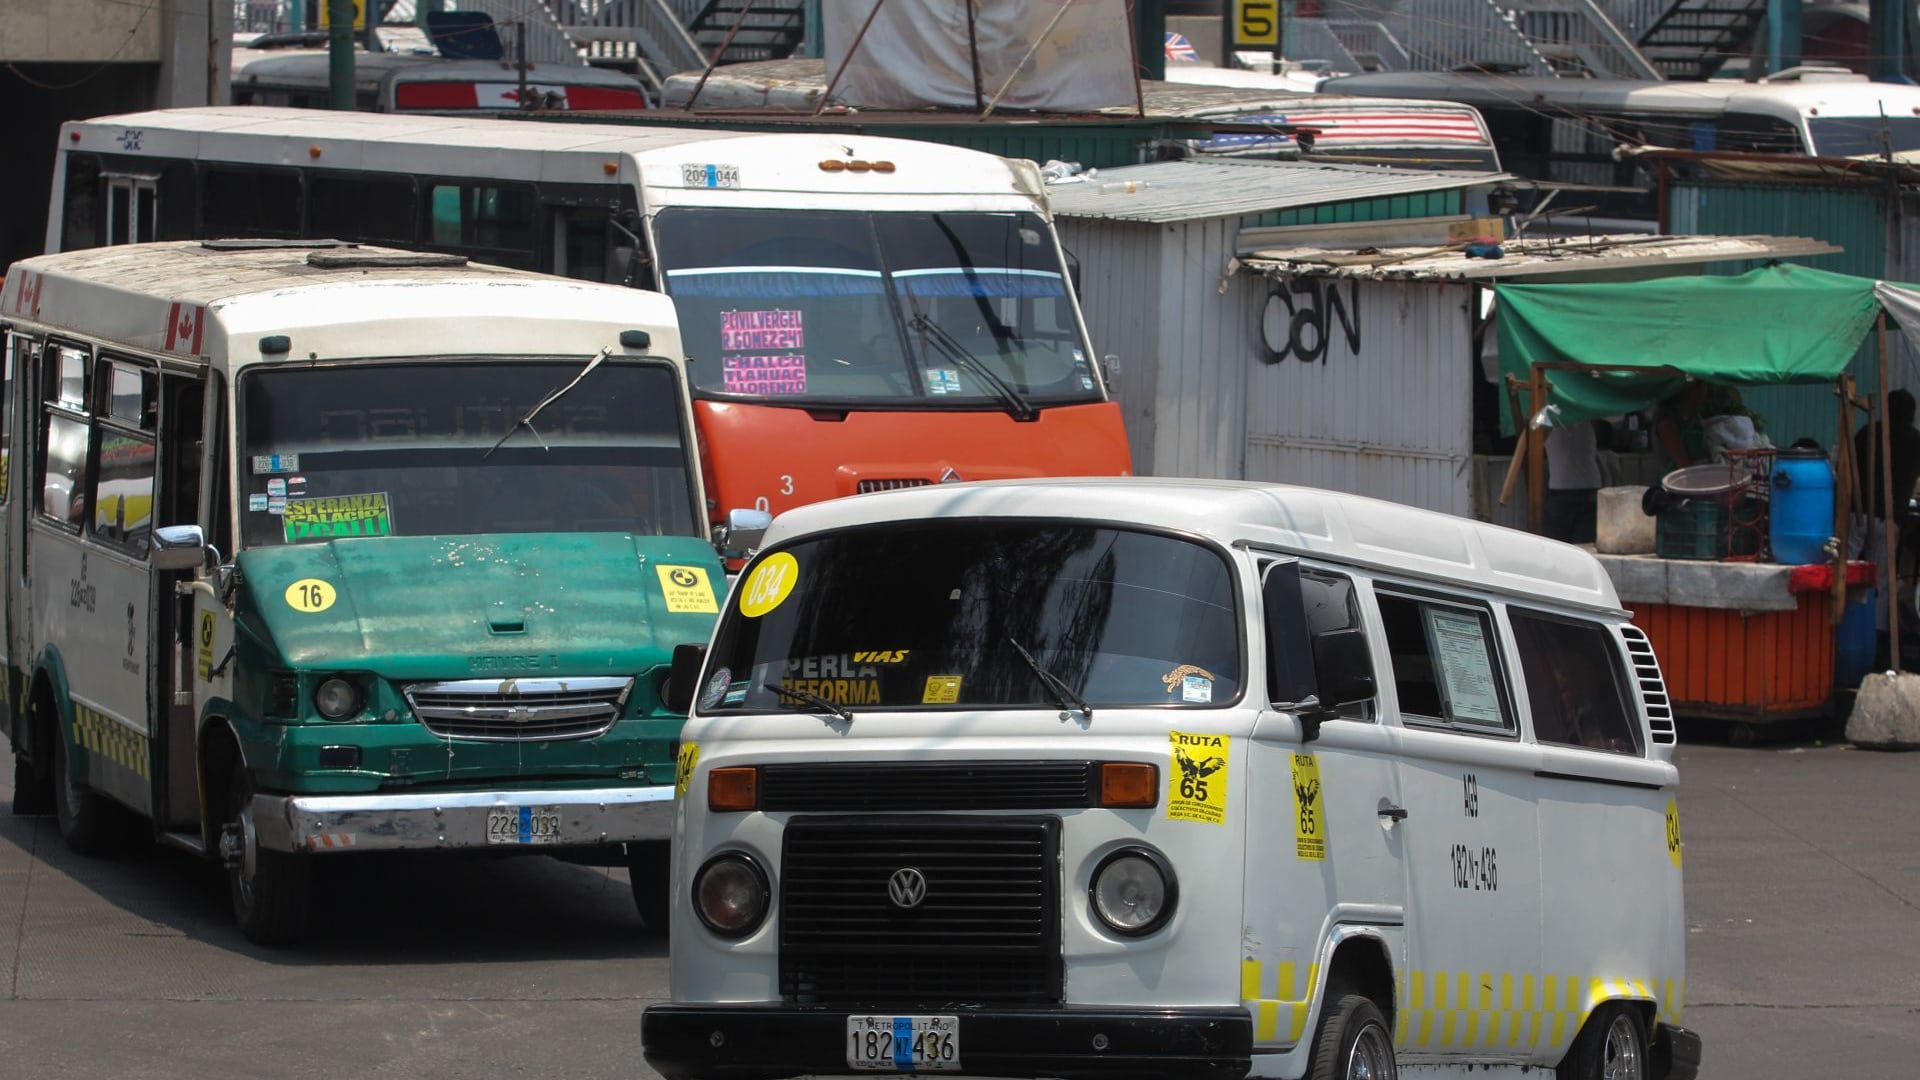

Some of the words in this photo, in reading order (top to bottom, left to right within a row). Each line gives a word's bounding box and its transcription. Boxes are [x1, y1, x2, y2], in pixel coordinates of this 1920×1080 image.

[1243, 4, 1272, 36] 5
[685, 169, 706, 182] 209
[716, 170, 738, 183] 044
[724, 357, 803, 369] CHALCO
[724, 368, 804, 381] TLAHUAC
[780, 475, 794, 495] 3
[285, 494, 386, 515] ESPERANZA
[748, 562, 788, 606] 034
[299, 584, 322, 608] 16
[784, 653, 877, 678] PERLA
[853, 650, 910, 663] VIAS
[780, 678, 880, 704] REFORMA
[1180, 735, 1222, 747] RUTA
[1295, 755, 1314, 767] RUTA
[1180, 778, 1208, 802] 65
[1463, 774, 1478, 818] AG9
[490, 816, 518, 834] 226
[1300, 809, 1315, 834] 65
[853, 1031, 893, 1060] 182
[912, 1031, 953, 1060] 436
